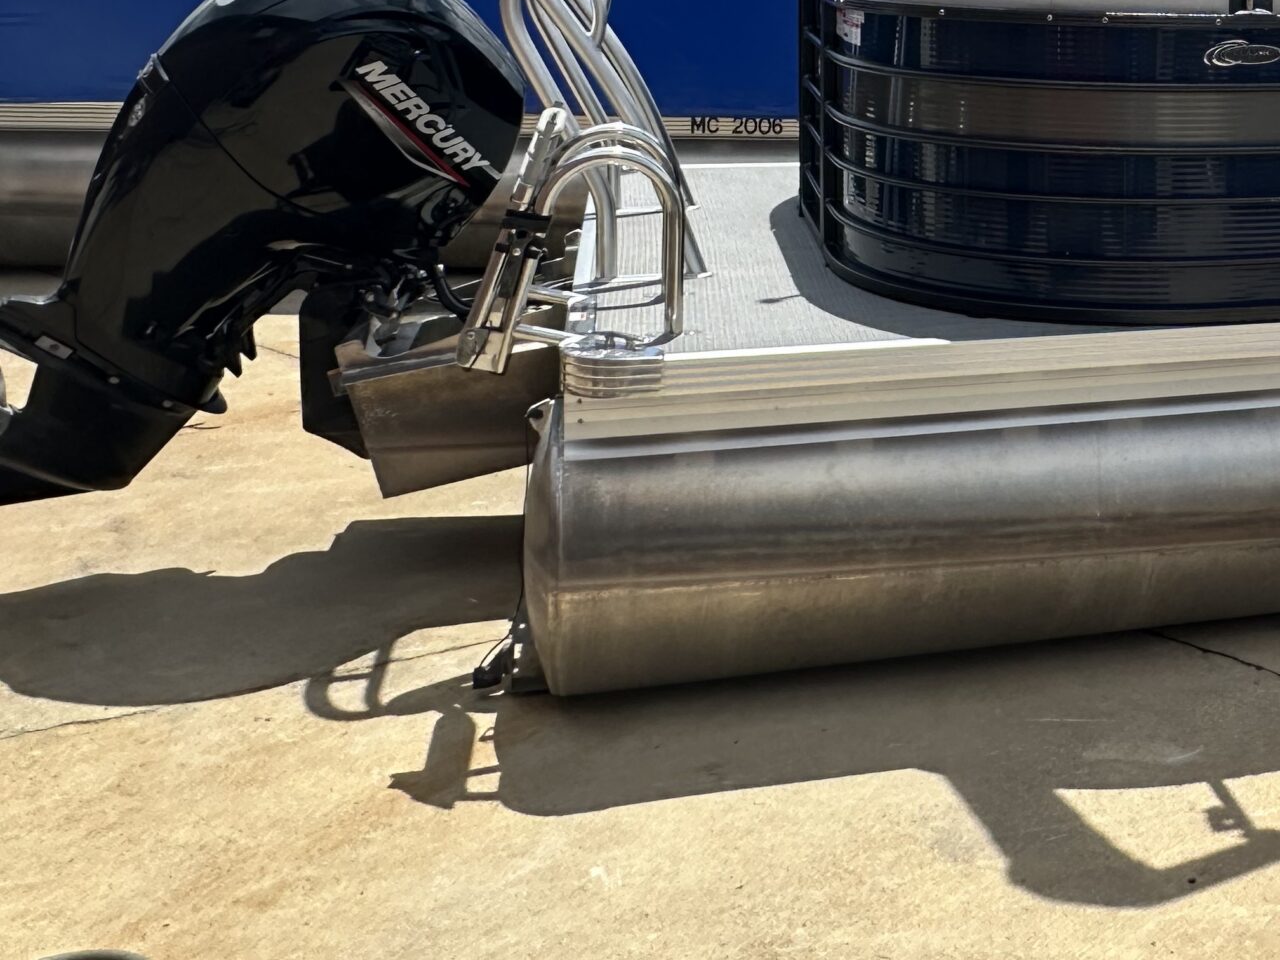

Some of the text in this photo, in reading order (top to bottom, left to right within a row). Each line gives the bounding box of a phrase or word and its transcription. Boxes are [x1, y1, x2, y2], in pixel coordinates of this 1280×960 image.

[354, 59, 501, 181] MERCURY
[690, 117, 783, 135] MC 2006
